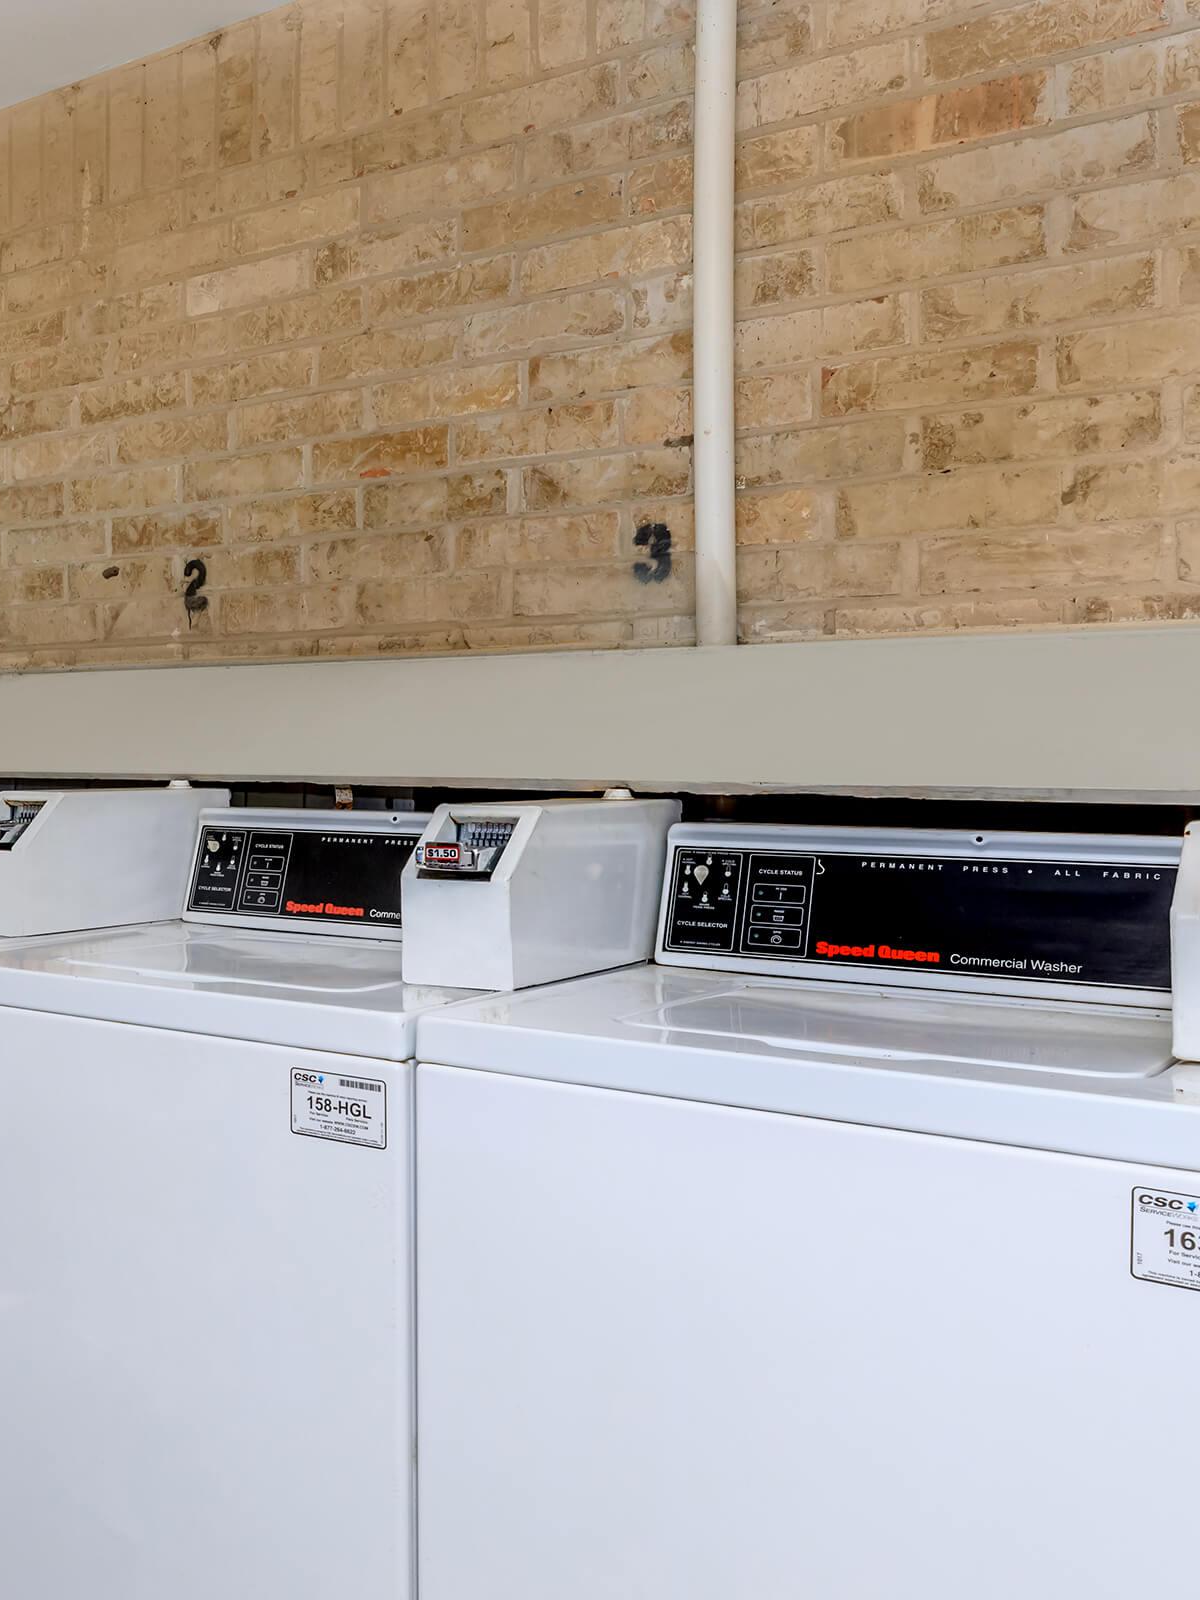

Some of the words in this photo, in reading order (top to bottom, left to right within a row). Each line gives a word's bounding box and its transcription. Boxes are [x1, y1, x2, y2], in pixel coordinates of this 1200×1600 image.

[632, 523, 671, 584] 3
[184, 559, 208, 614] 2
[321, 837, 374, 845] PERMANENT
[427, 848, 457, 858] $1.50
[759, 868, 778, 876] CYCLE
[779, 869, 803, 877] STATUS
[861, 861, 944, 871] PERMANENT
[963, 865, 1009, 874] PRESS
[1054, 869, 1081, 877] ALL
[1103, 871, 1162, 881] FABRIC
[285, 901, 324, 914] Speed
[325, 903, 364, 917] Queen
[697, 921, 728, 929] SELECTOR
[815, 941, 875, 957] Speed
[877, 945, 940, 963] Queen
[950, 953, 1027, 969] Commercial
[1030, 959, 1083, 974] Washer
[294, 1072, 317, 1083] CSC
[307, 1095, 372, 1119] 158-HGL
[1138, 1194, 1184, 1210] CSC
[1164, 1228, 1200, 1251] 16
